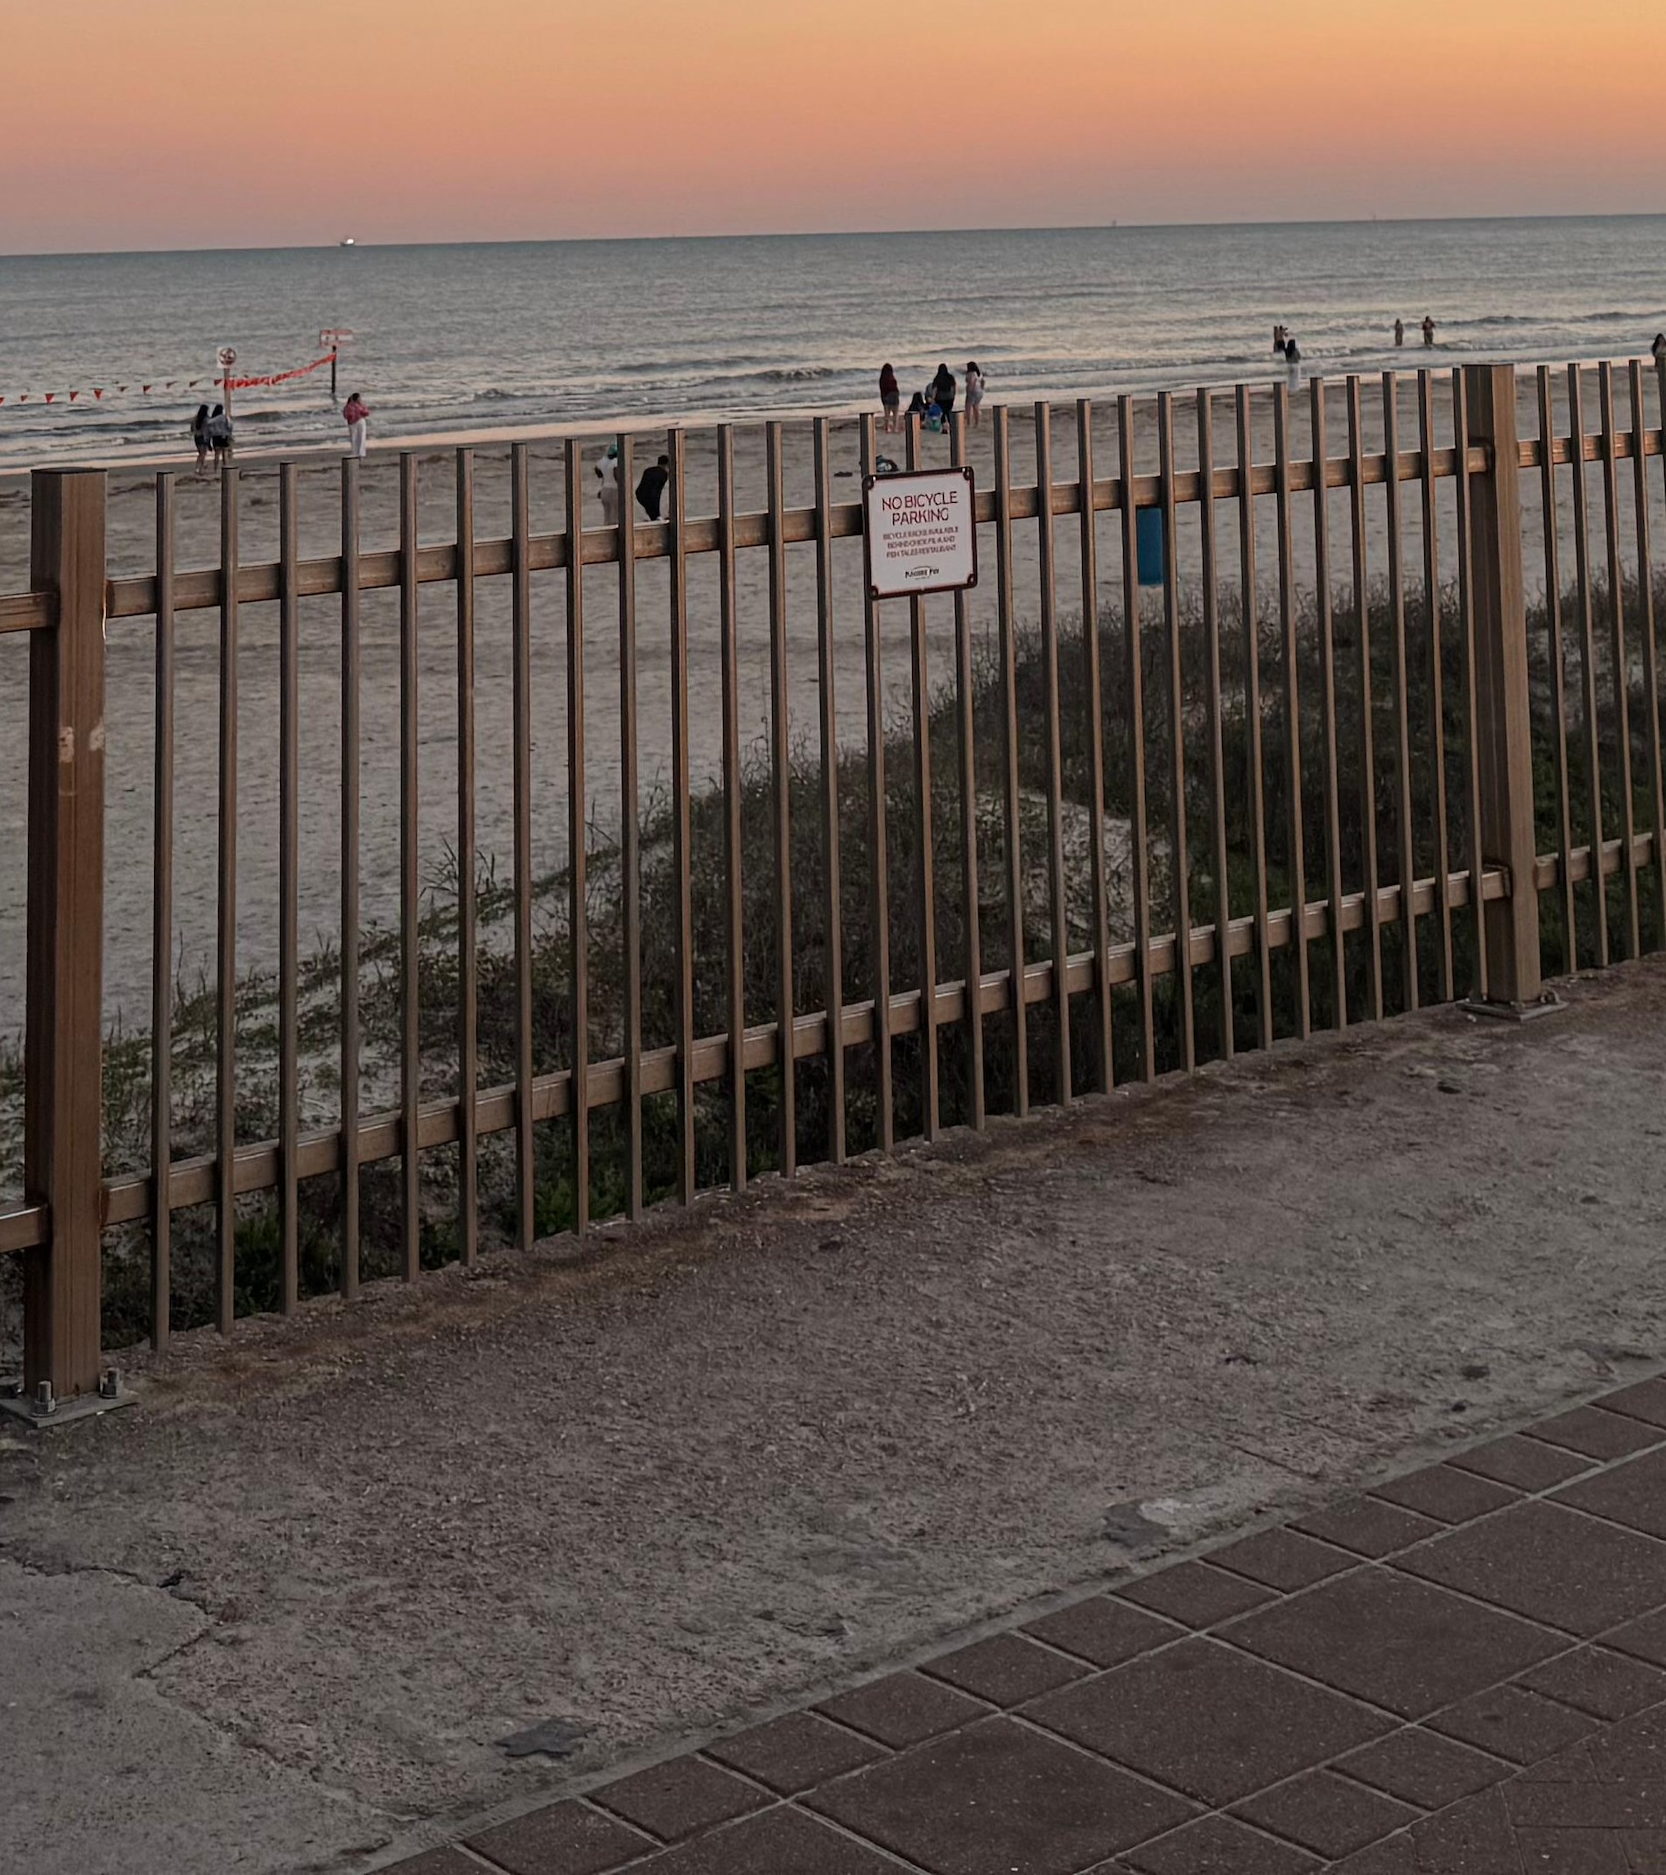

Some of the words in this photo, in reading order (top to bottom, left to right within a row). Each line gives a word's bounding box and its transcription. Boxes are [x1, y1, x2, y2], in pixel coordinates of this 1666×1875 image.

[882, 496, 902, 512] NO
[905, 491, 958, 508] BICYCLE
[892, 507, 949, 526] PARKING
